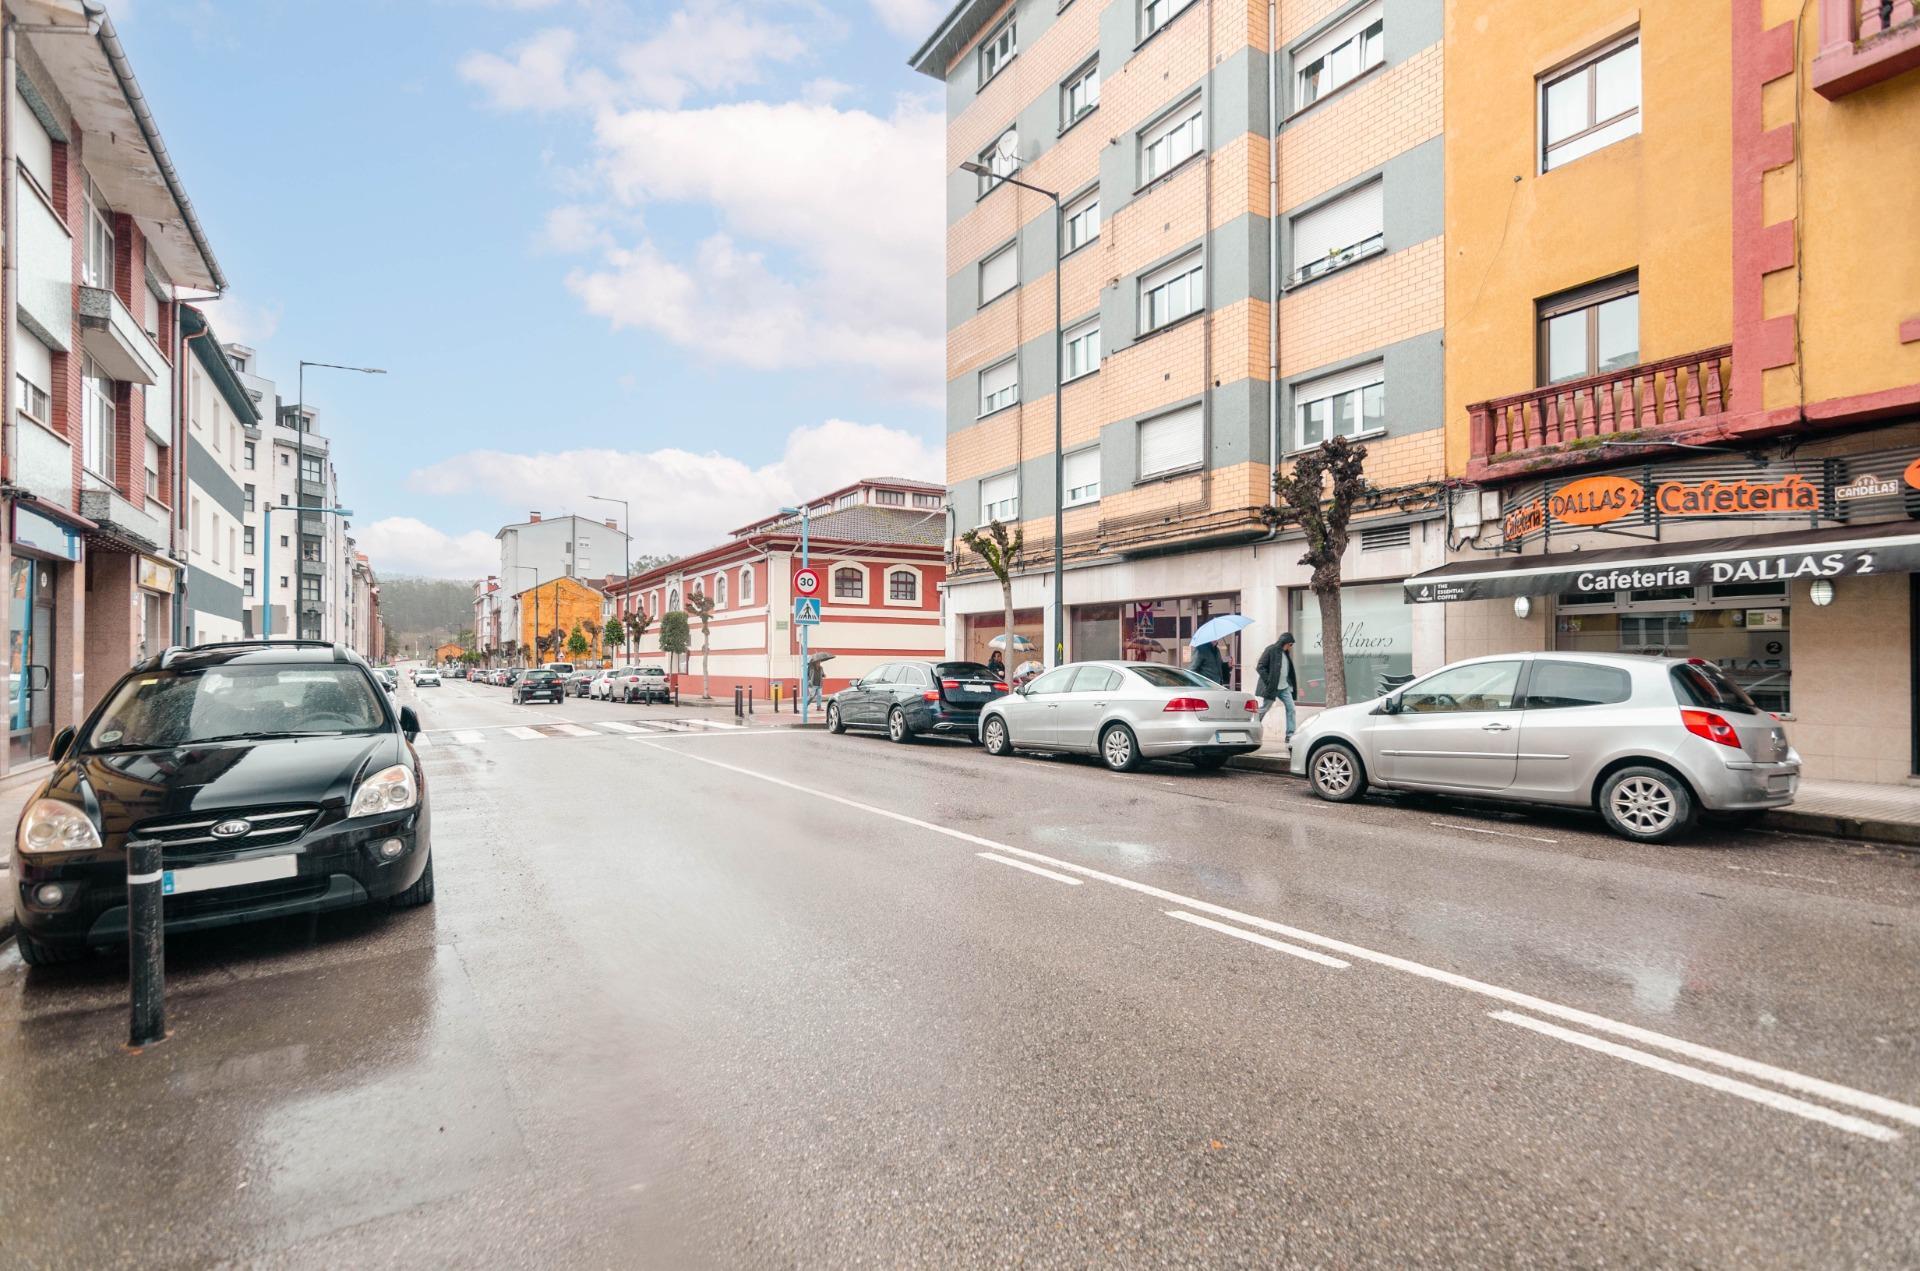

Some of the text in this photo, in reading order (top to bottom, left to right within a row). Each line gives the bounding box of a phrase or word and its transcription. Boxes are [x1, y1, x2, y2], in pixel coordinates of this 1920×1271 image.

[1552, 487, 1640, 516] DALLAS 2
[1660, 479, 1815, 511] Cafetería
[1836, 482, 1897, 498] CANDELAS
[800, 577, 814, 587] 30
[1577, 553, 1875, 591] Cafetería DALLAS 2
[1313, 621, 1393, 648] bliners
[1718, 659, 1782, 670] LLAS
